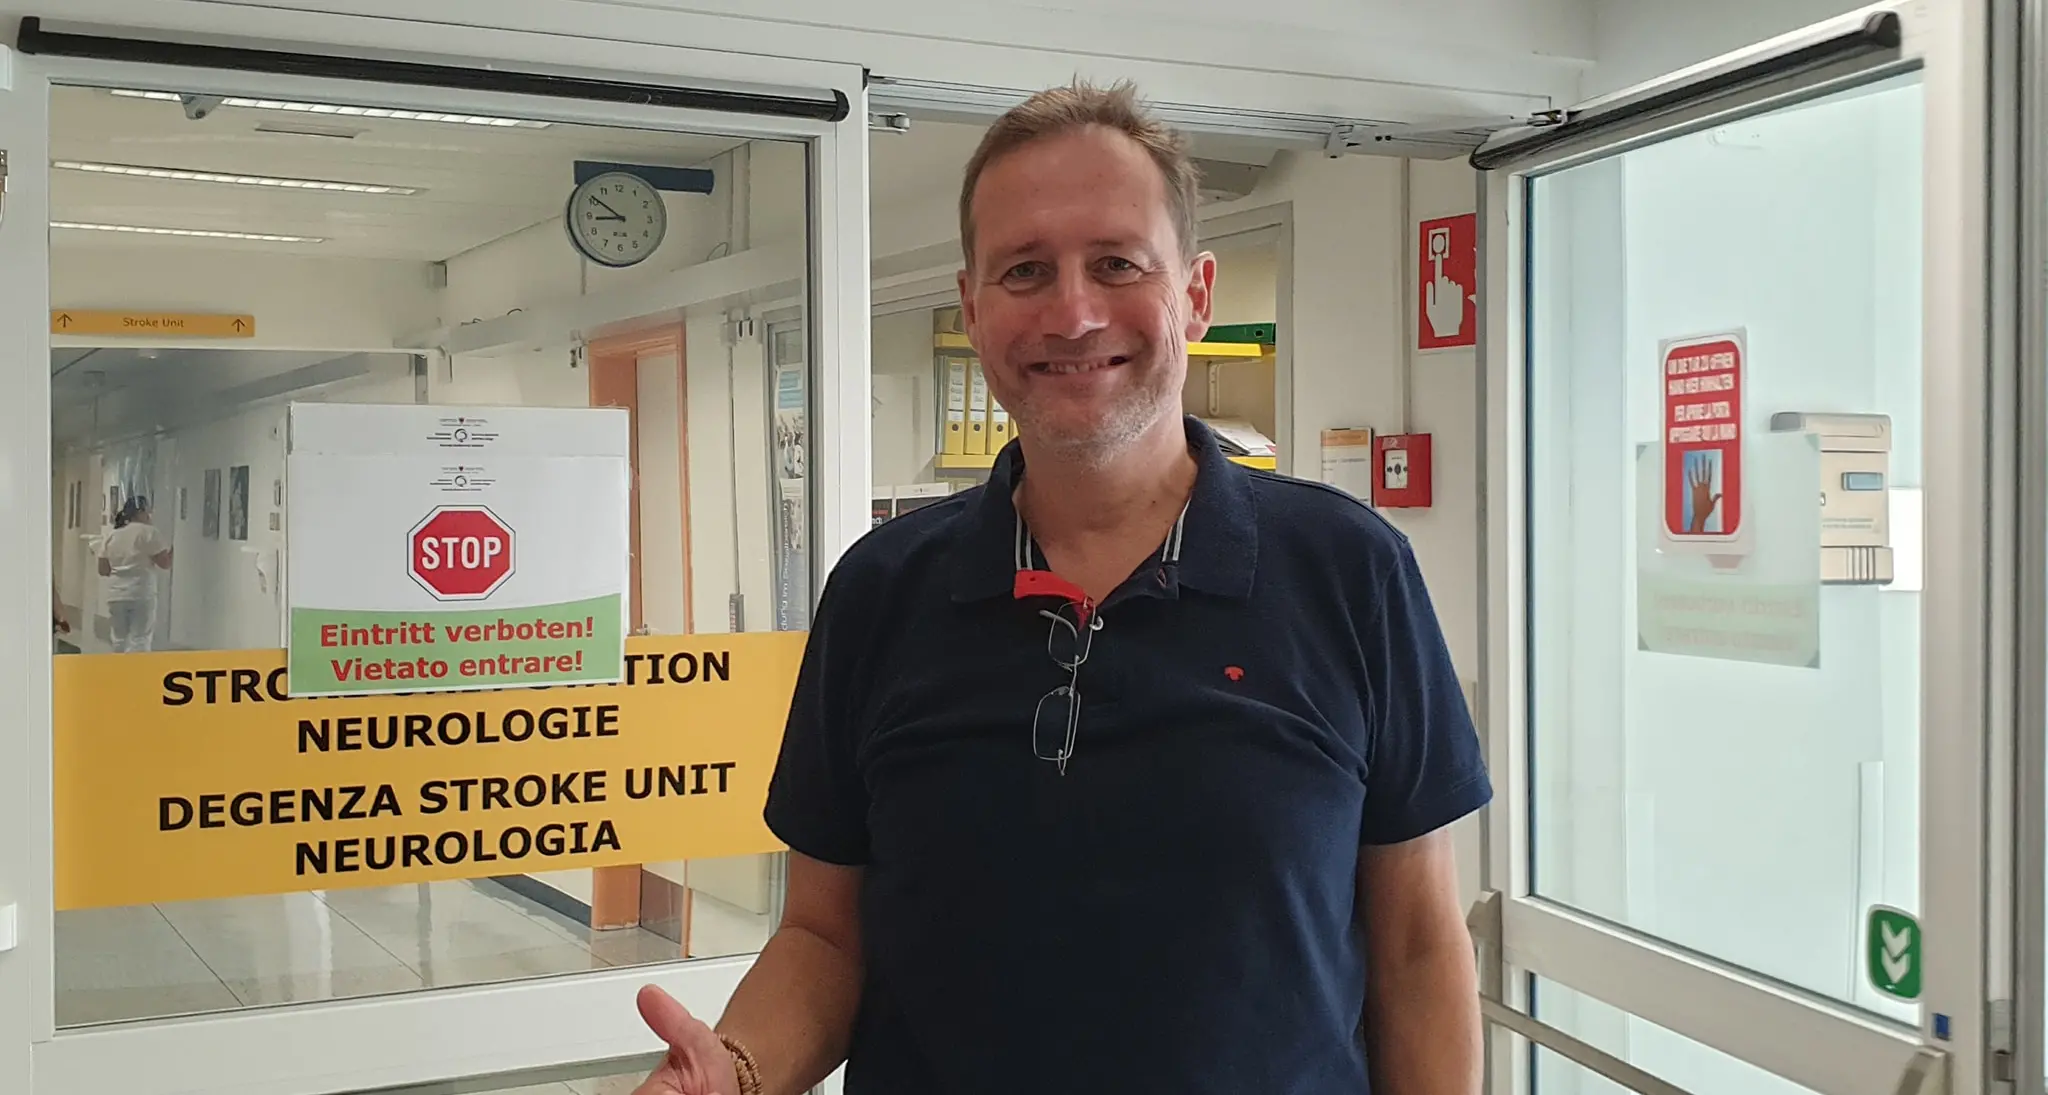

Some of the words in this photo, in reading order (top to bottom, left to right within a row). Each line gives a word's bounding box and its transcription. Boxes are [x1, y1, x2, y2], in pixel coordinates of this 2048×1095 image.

[600, 187, 608, 195] 11
[614, 184, 624, 193] 12
[643, 201, 649, 209] 2
[586, 211, 592, 219] 9
[646, 215, 653, 224] 3
[591, 227, 598, 236] 8
[642, 230, 649, 238] 4
[602, 239, 609, 247] 7
[632, 240, 638, 249] 5
[617, 244, 624, 252] 6
[122, 317, 158, 328] Stroke
[162, 318, 184, 328] Unit
[421, 536, 502, 571] STOP
[321, 622, 435, 648] Eintritt
[445, 616, 593, 642] verboten!
[331, 658, 448, 682] Vietato
[459, 650, 583, 677] entrare!
[298, 705, 619, 753] NEUROLOGIE
[159, 784, 402, 831] DEGENZA
[419, 770, 607, 814] STROKE
[624, 761, 736, 799] UNIT
[295, 820, 622, 876] NEUROLOGIA
